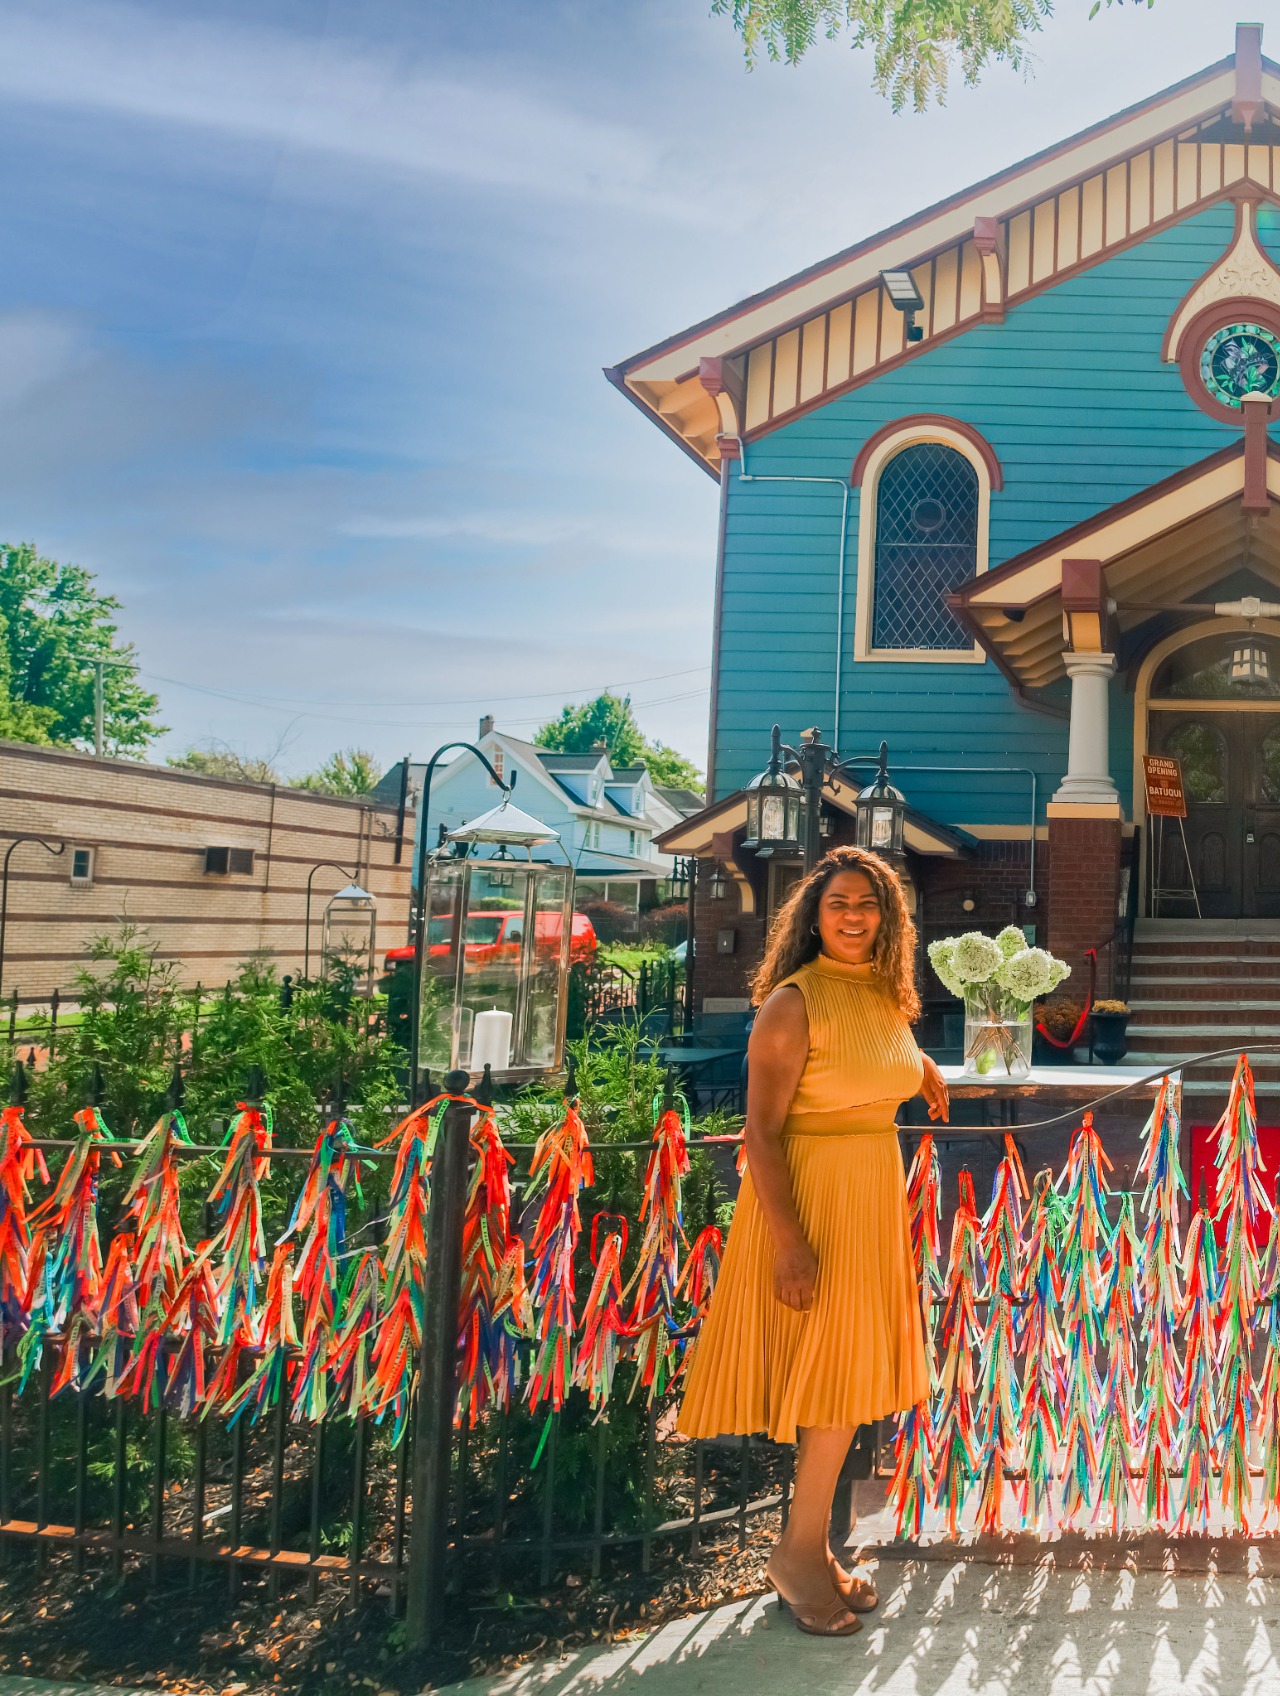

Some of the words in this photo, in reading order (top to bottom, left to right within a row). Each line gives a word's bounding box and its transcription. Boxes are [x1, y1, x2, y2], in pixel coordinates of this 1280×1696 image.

[1149, 758, 1174, 769] GRAND
[1147, 766, 1178, 777] OPENING
[1149, 786, 1182, 798] BATUQUI
